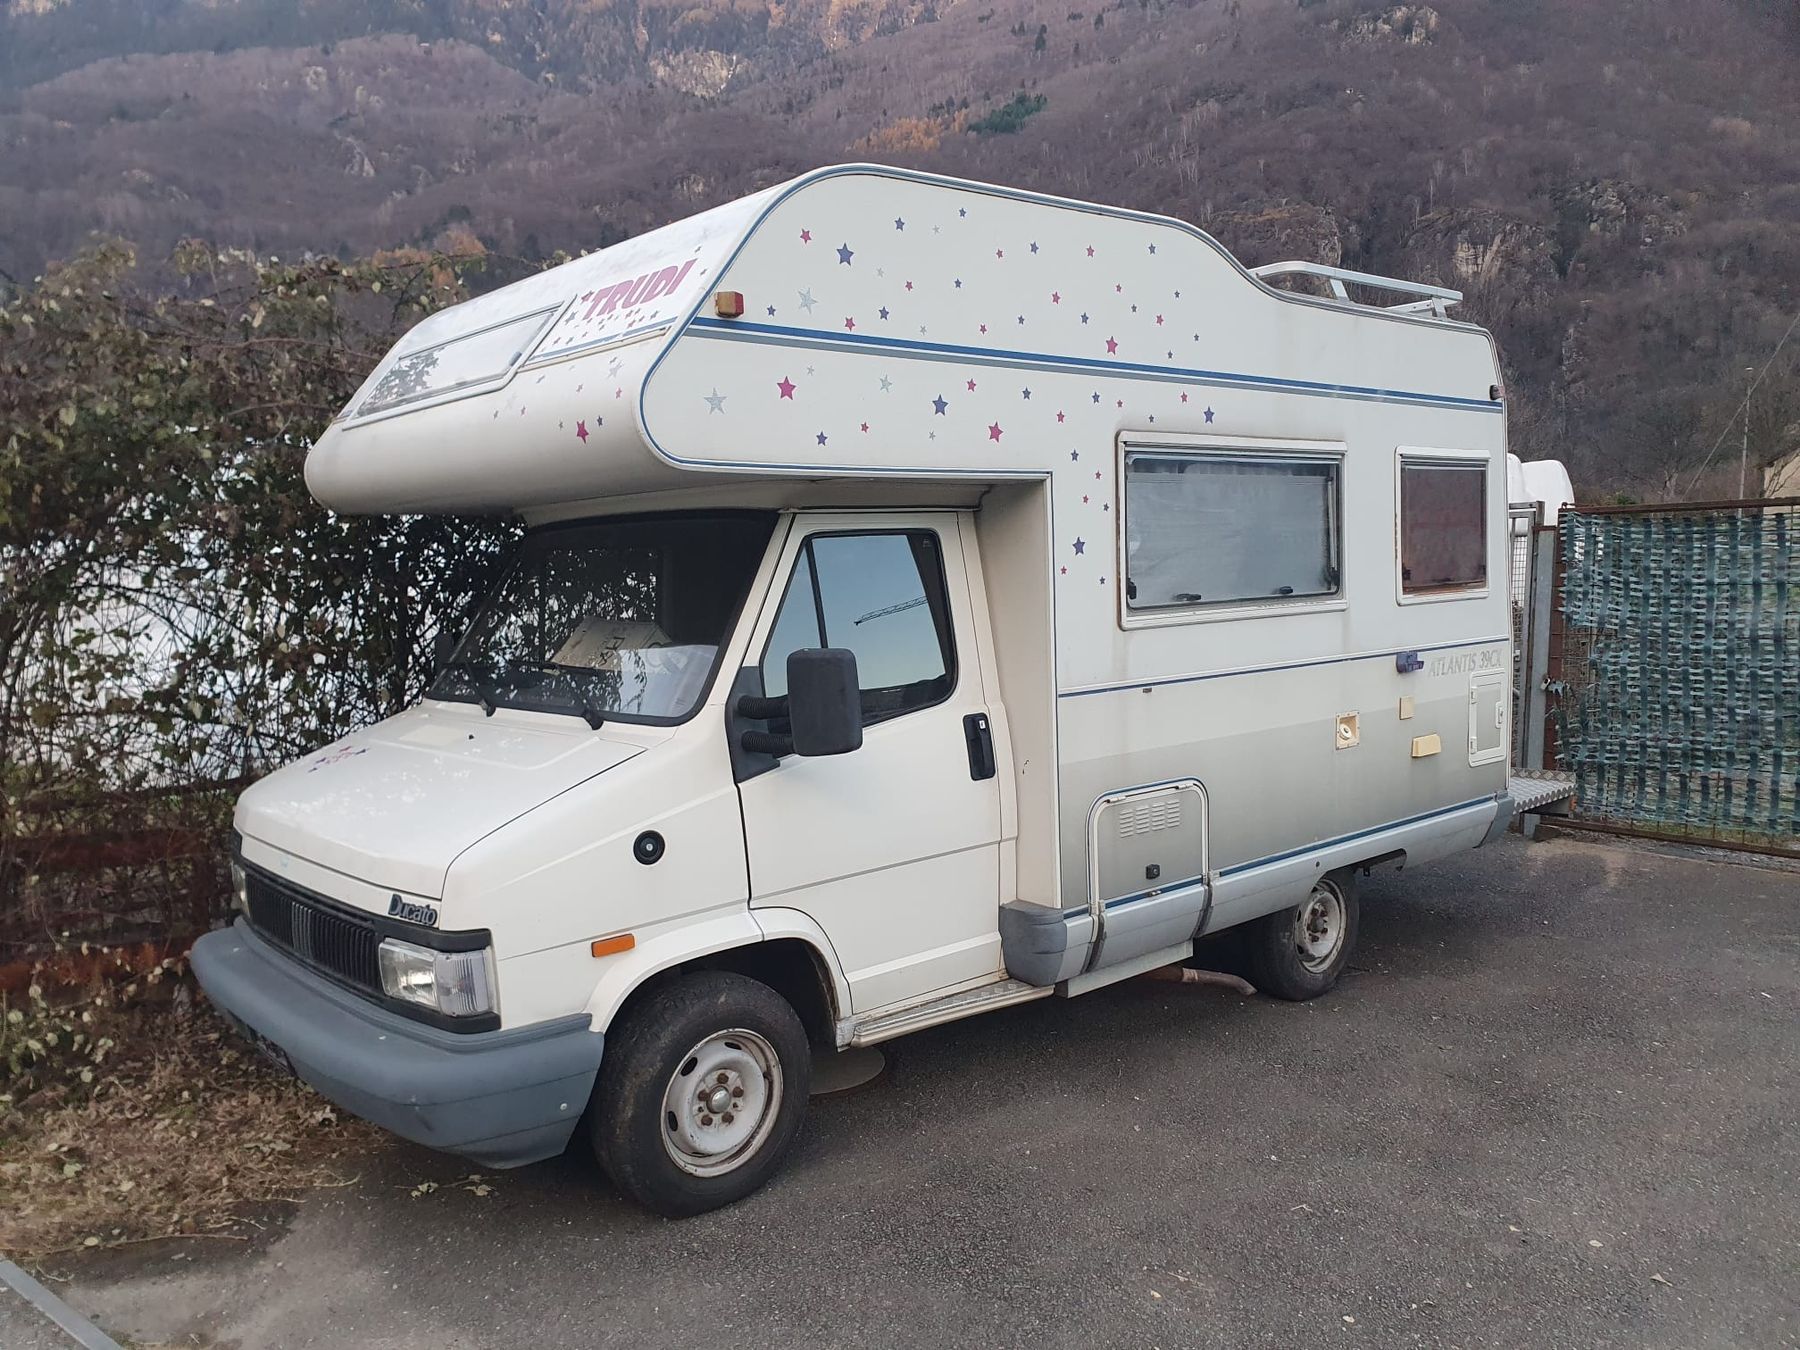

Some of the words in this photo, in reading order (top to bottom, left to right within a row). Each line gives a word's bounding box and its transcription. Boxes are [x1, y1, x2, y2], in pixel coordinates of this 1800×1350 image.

[582, 258, 698, 321] TRUDI
[1429, 652, 1477, 677] ATLANTIS
[388, 893, 438, 926] Ducato
